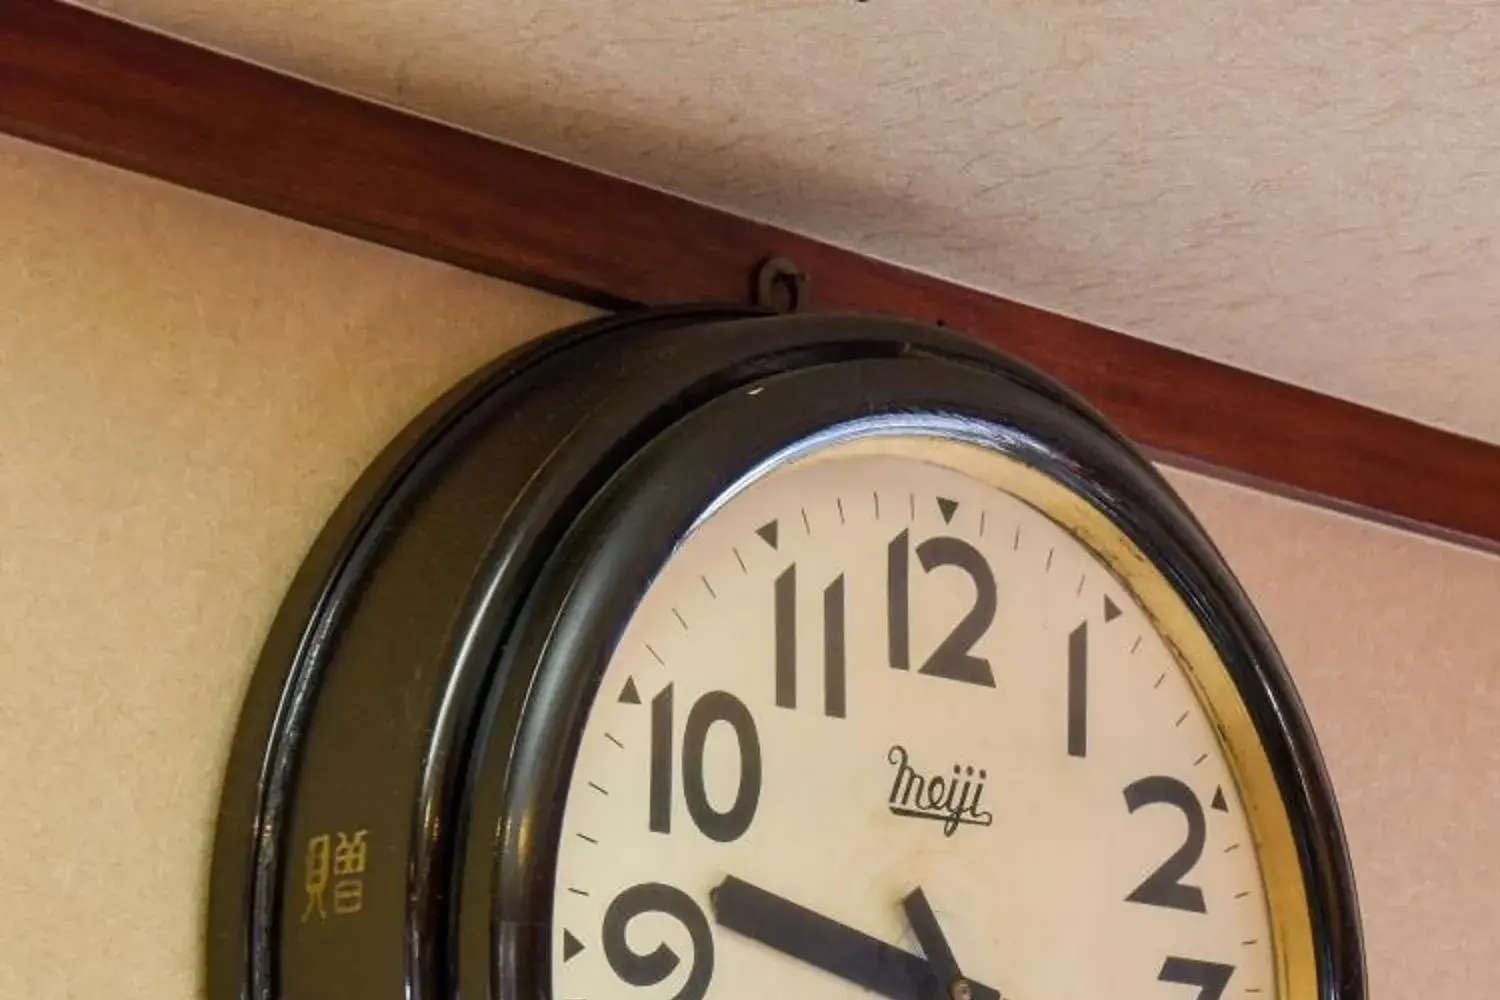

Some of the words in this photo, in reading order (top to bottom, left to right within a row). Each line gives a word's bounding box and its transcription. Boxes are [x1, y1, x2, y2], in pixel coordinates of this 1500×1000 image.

[776, 564, 845, 718] 11
[888, 528, 996, 688] 12
[1068, 623, 1086, 757] 1
[650, 684, 761, 842] 10
[887, 745, 992, 837] Meiji
[1123, 776, 1206, 913] 2
